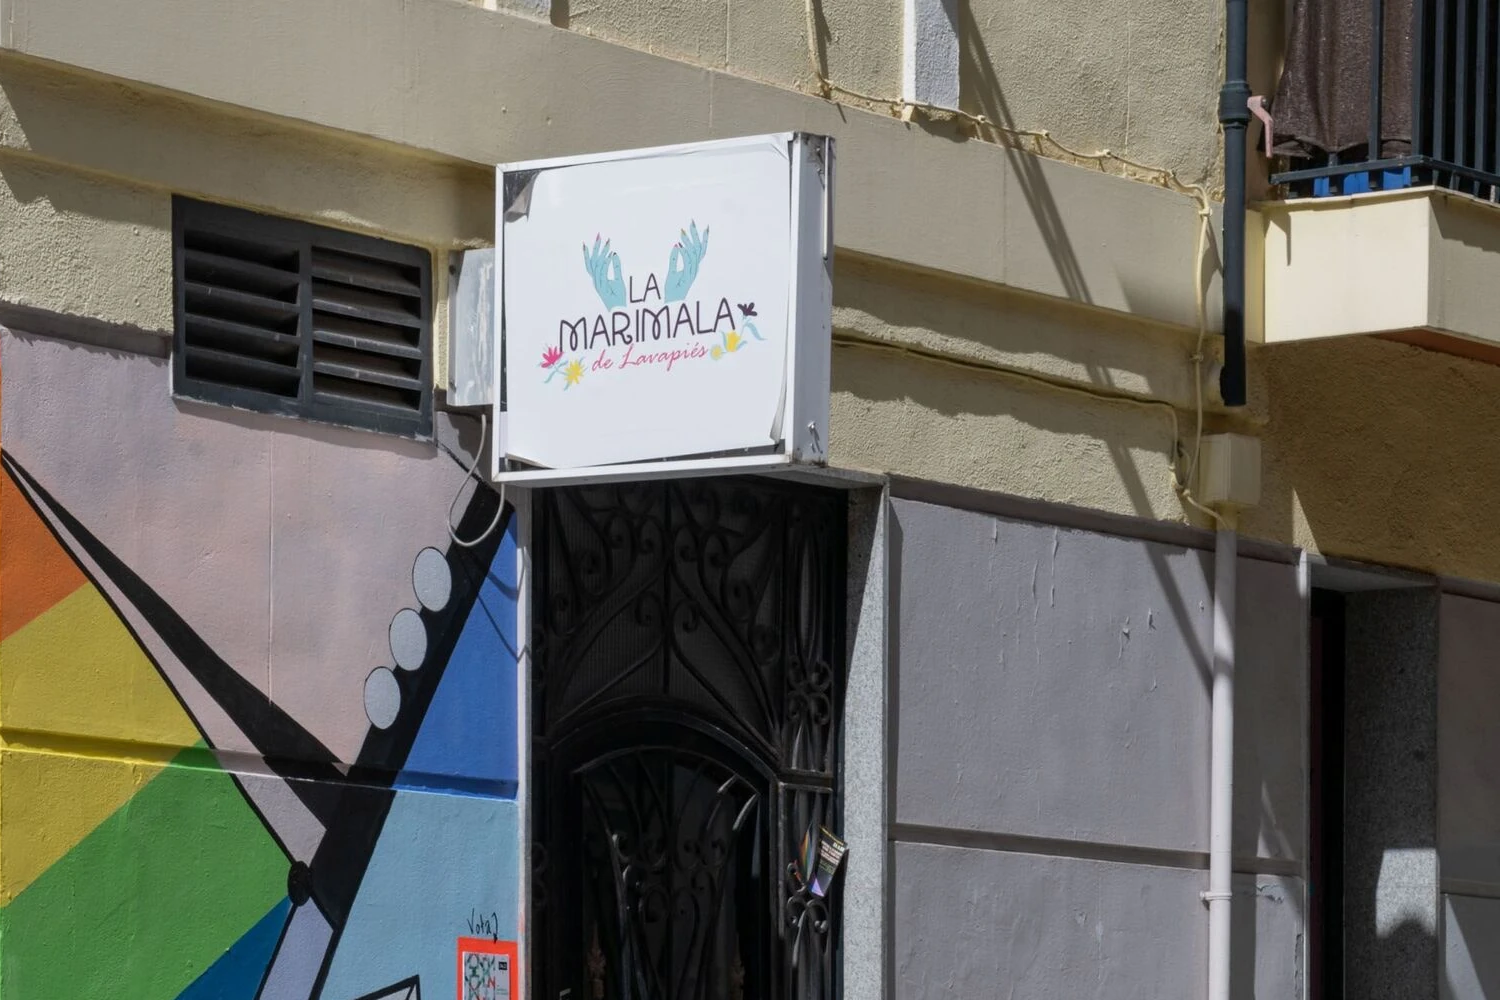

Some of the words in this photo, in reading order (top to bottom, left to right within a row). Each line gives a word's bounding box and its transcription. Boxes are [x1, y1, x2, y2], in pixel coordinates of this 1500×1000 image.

[629, 272, 661, 303] LA
[560, 297, 735, 352] MARIMALA
[591, 349, 613, 372] de
[618, 341, 709, 372] Lavapiés
[466, 907, 492, 935] Vota
